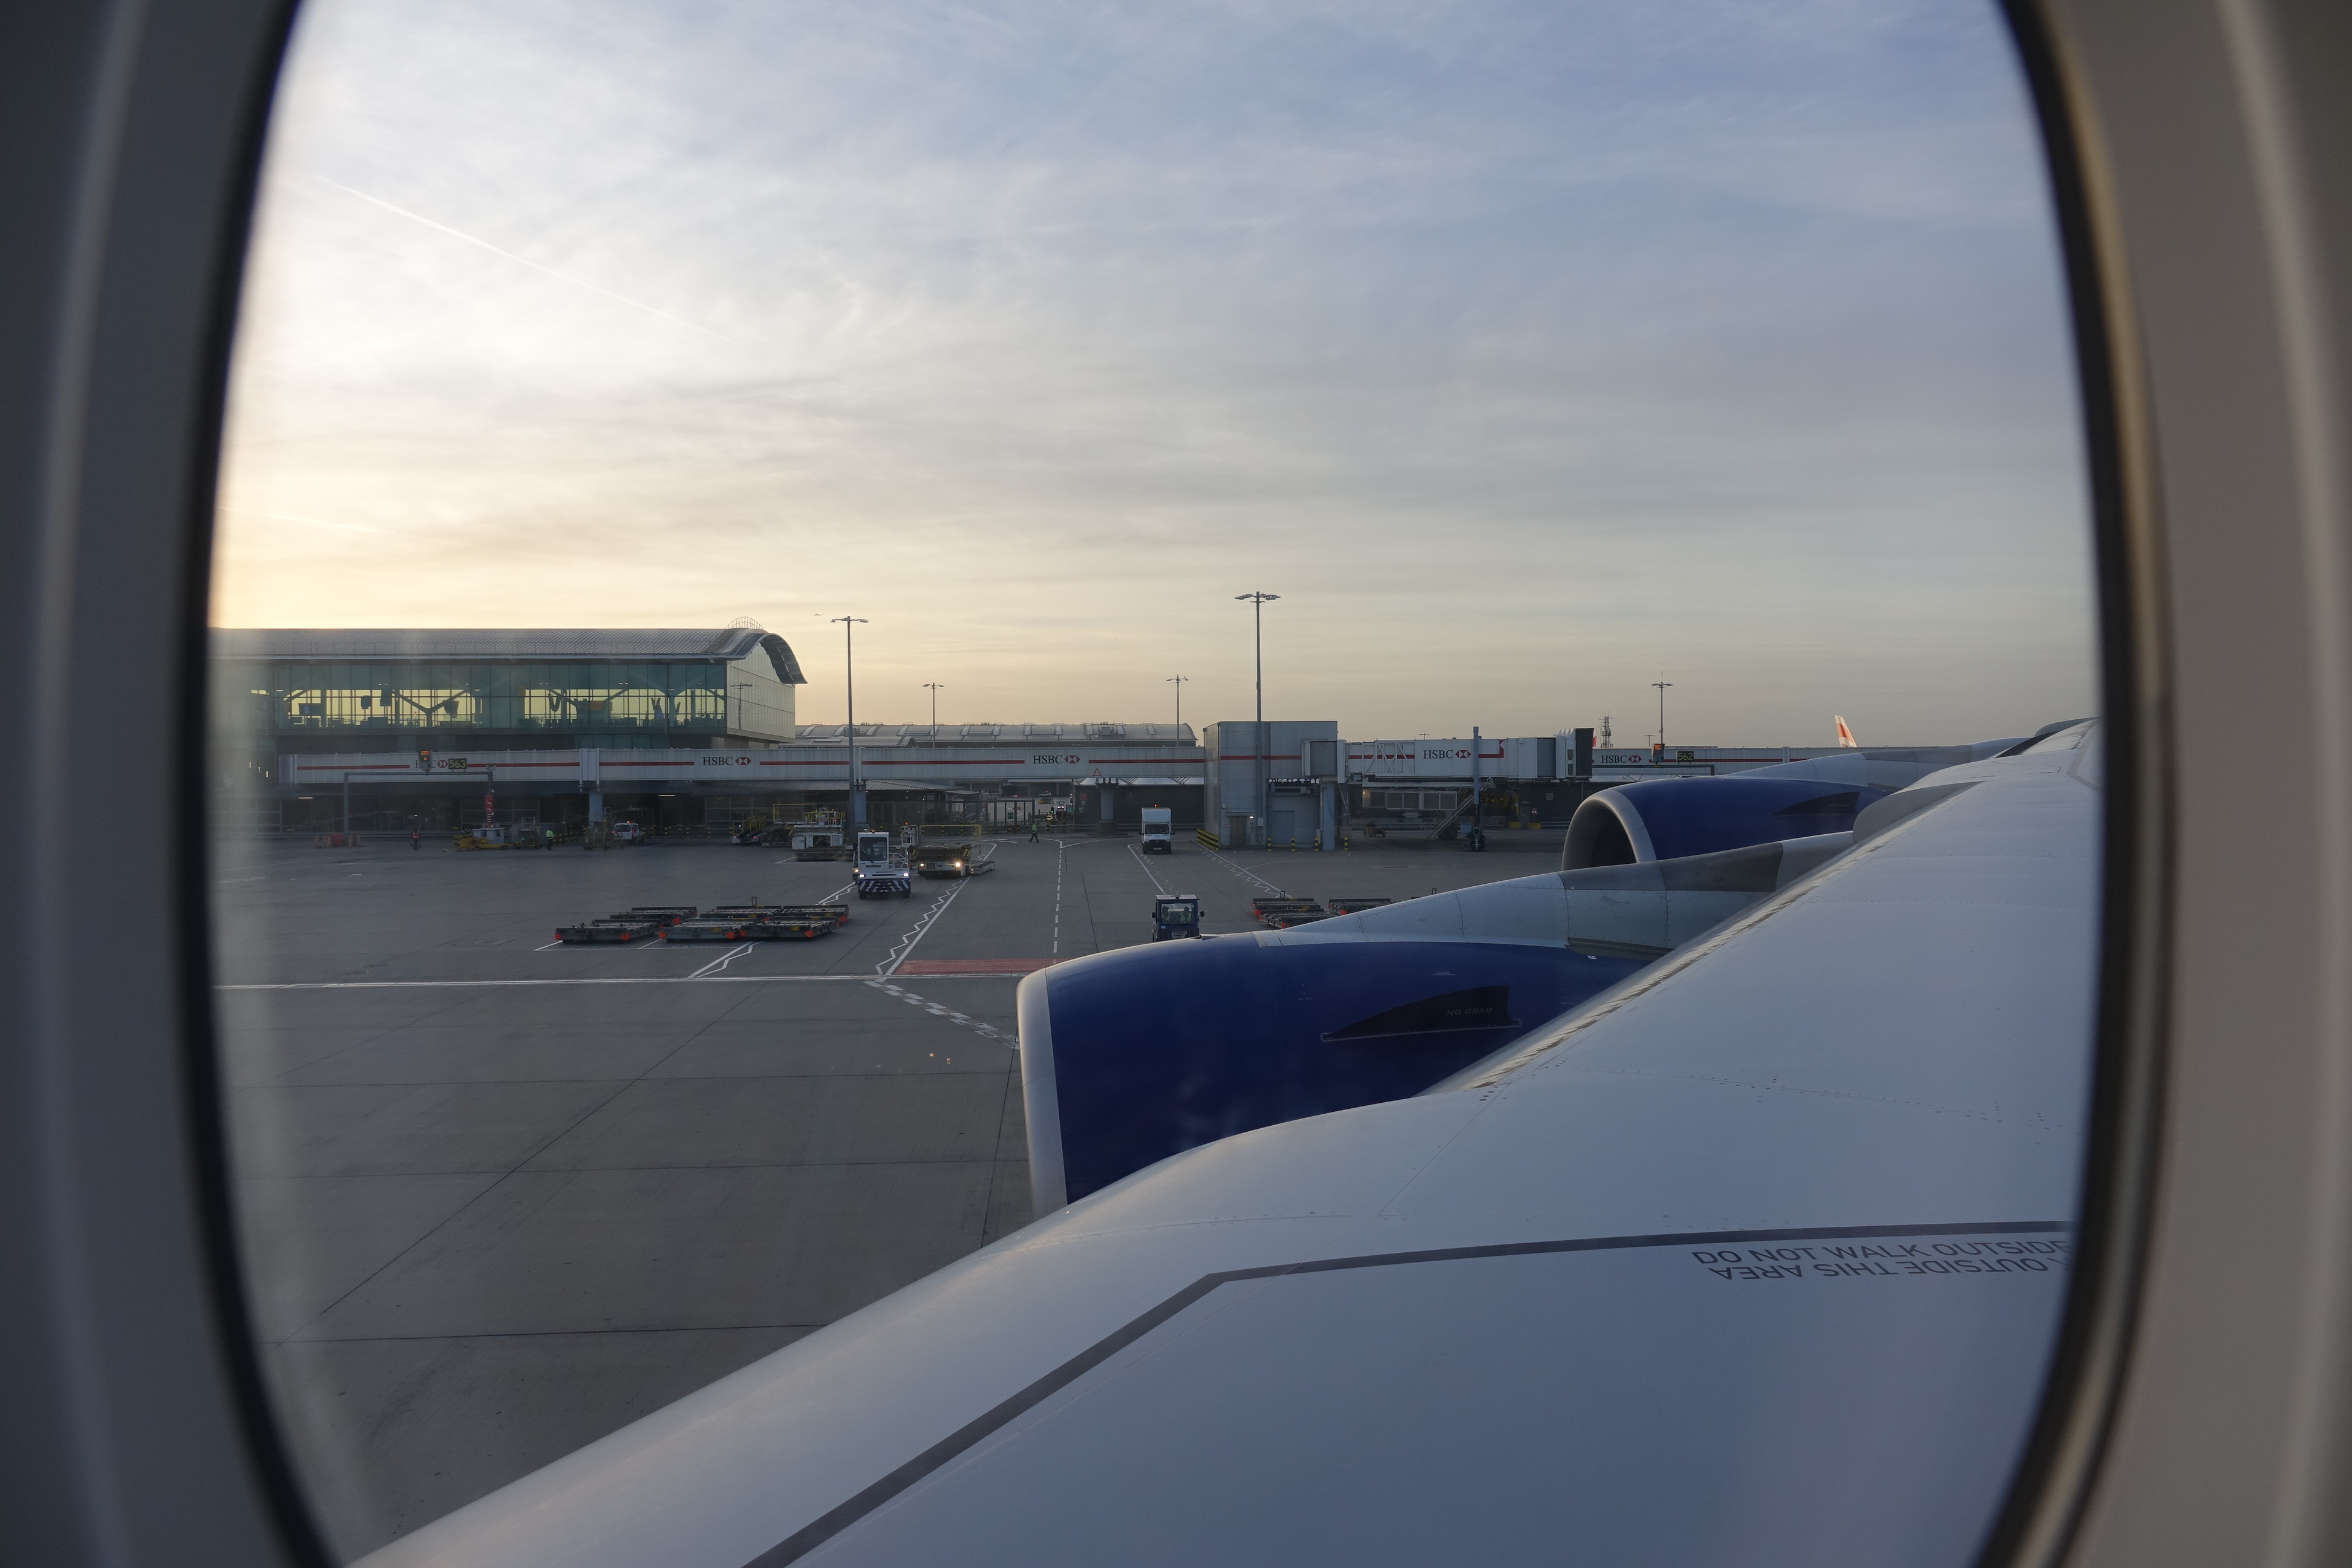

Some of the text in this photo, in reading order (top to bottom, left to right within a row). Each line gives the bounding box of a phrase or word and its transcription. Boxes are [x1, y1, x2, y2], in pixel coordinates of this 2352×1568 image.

[1423, 750, 1454, 759] HSBC
[1601, 755, 1627, 763] HSBC
[1677, 752, 1693, 760] 562
[448, 760, 466, 768] 563
[702, 756, 734, 766] HSBC
[1033, 755, 1063, 764] HSBC
[1691, 1250, 1742, 1264] DO
[1748, 1247, 1817, 1262] NOT
[1822, 1244, 1932, 1259] WALK
[1812, 1262, 1899, 1276] THIS
[1895, 1258, 2049, 1274] OUTSIDE
[1707, 1265, 1803, 1280] AREA
